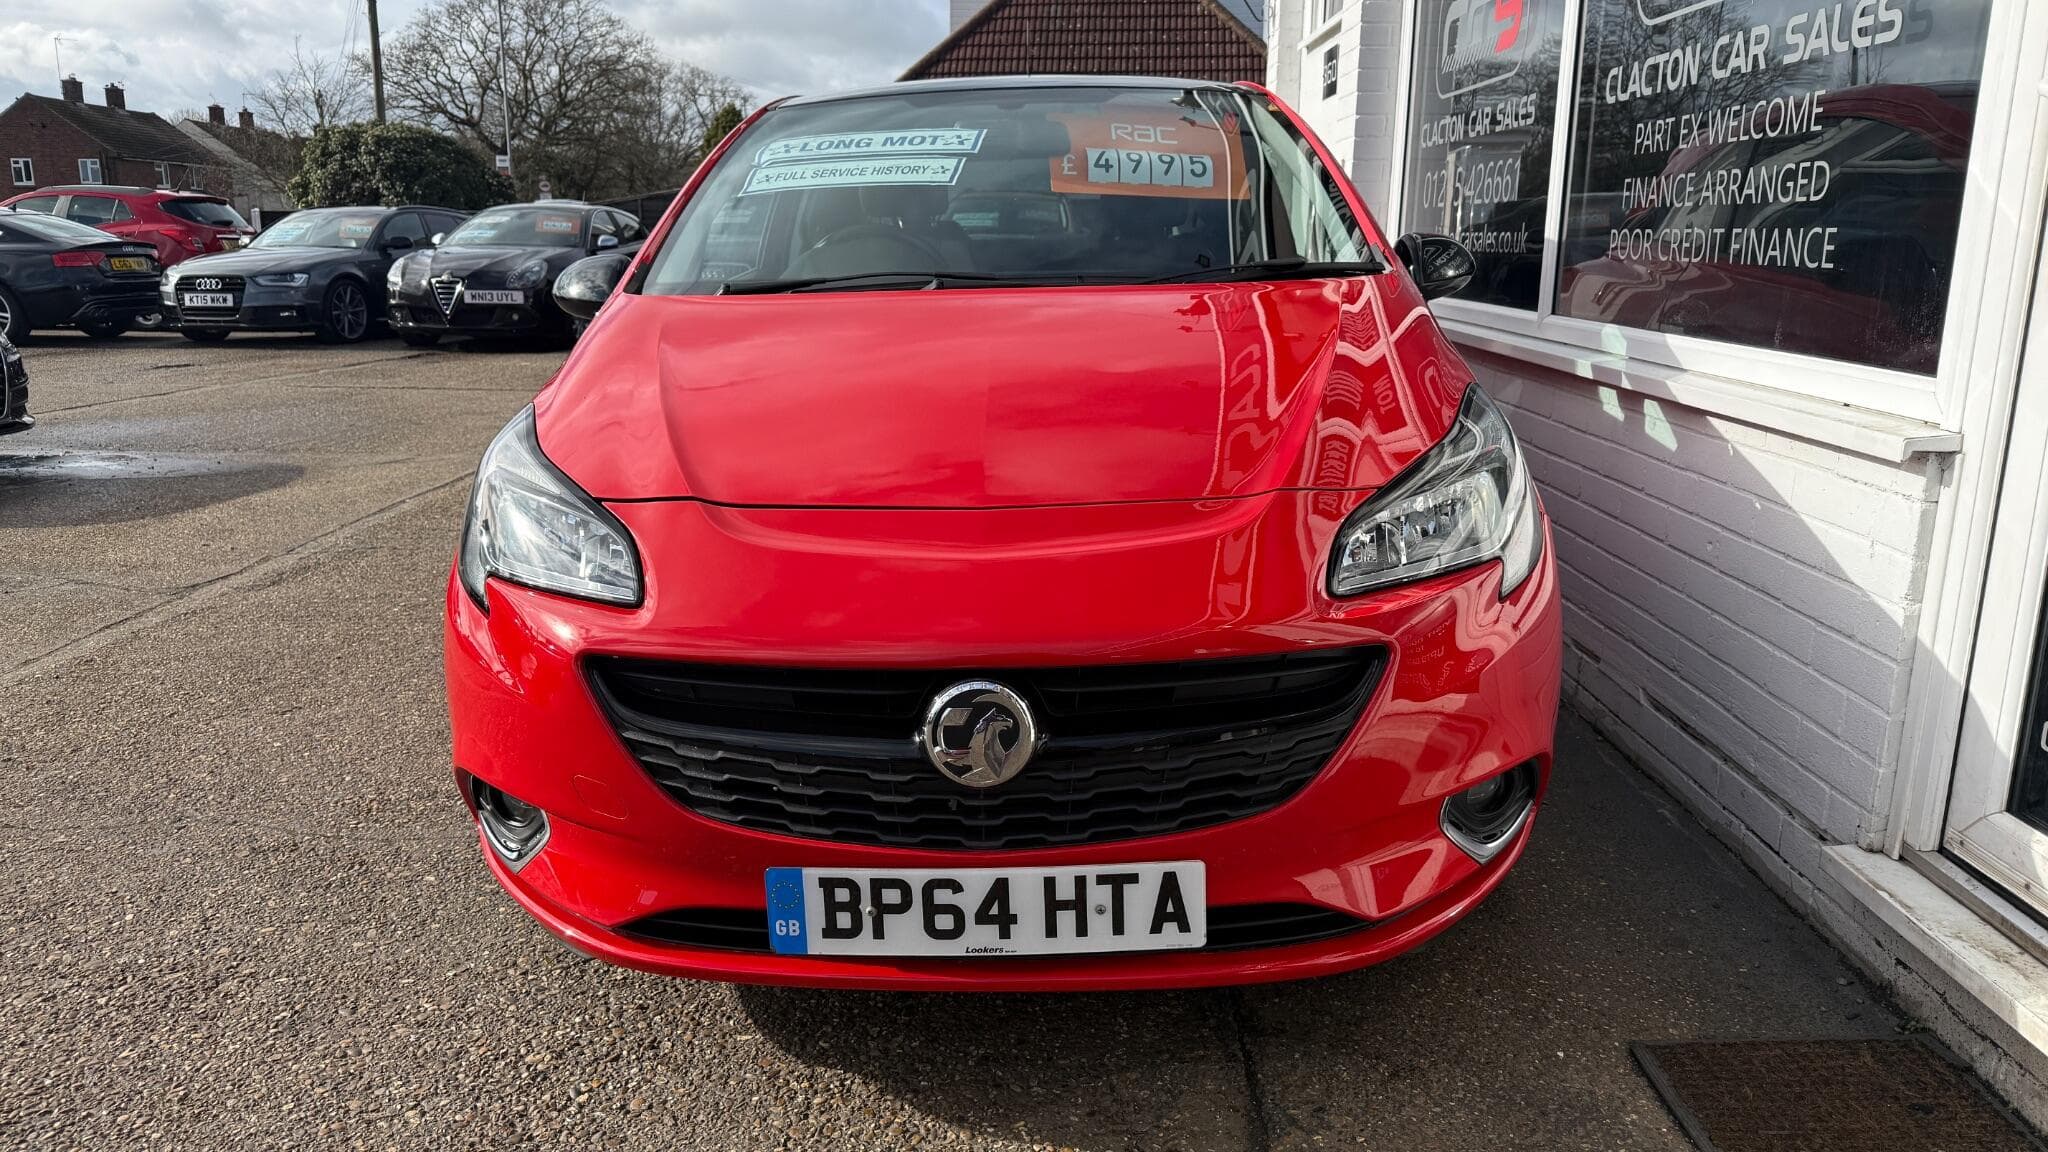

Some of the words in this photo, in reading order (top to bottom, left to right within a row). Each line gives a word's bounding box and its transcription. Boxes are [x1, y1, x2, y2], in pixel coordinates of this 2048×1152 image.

[1606, 43, 1702, 105] CLACTON
[1711, 24, 1770, 80] CAR
[1783, 0, 1904, 65] SALES
[1421, 113, 1466, 148] CLACTON
[1468, 106, 1492, 138] CAR
[1495, 92, 1537, 132] SALES
[1633, 116, 1675, 155] PART
[1679, 111, 1703, 149] EX
[1708, 89, 1827, 145] WELCOME
[798, 138, 873, 153] LONG
[881, 135, 945, 148] MOT
[774, 168, 807, 183] FULL
[811, 166, 868, 179] SERVICE
[871, 164, 931, 176] HISTORY
[1093, 150, 1208, 178] 4995
[1622, 172, 1696, 209] FINANCE
[1699, 160, 1831, 206] ARRANGED
[1608, 228, 1653, 261] POOR
[1658, 228, 1725, 264] CREDIT
[1729, 227, 1838, 269] FINANCE
[189, 295, 208, 305] KT15
[209, 295, 228, 305] WKW
[470, 292, 494, 302] WN13
[496, 292, 517, 302] UYL
[818, 876, 1018, 940] BP64
[1043, 871, 1191, 939] HTA
[775, 919, 801, 937] GB
[965, 946, 1004, 954] Lookers
